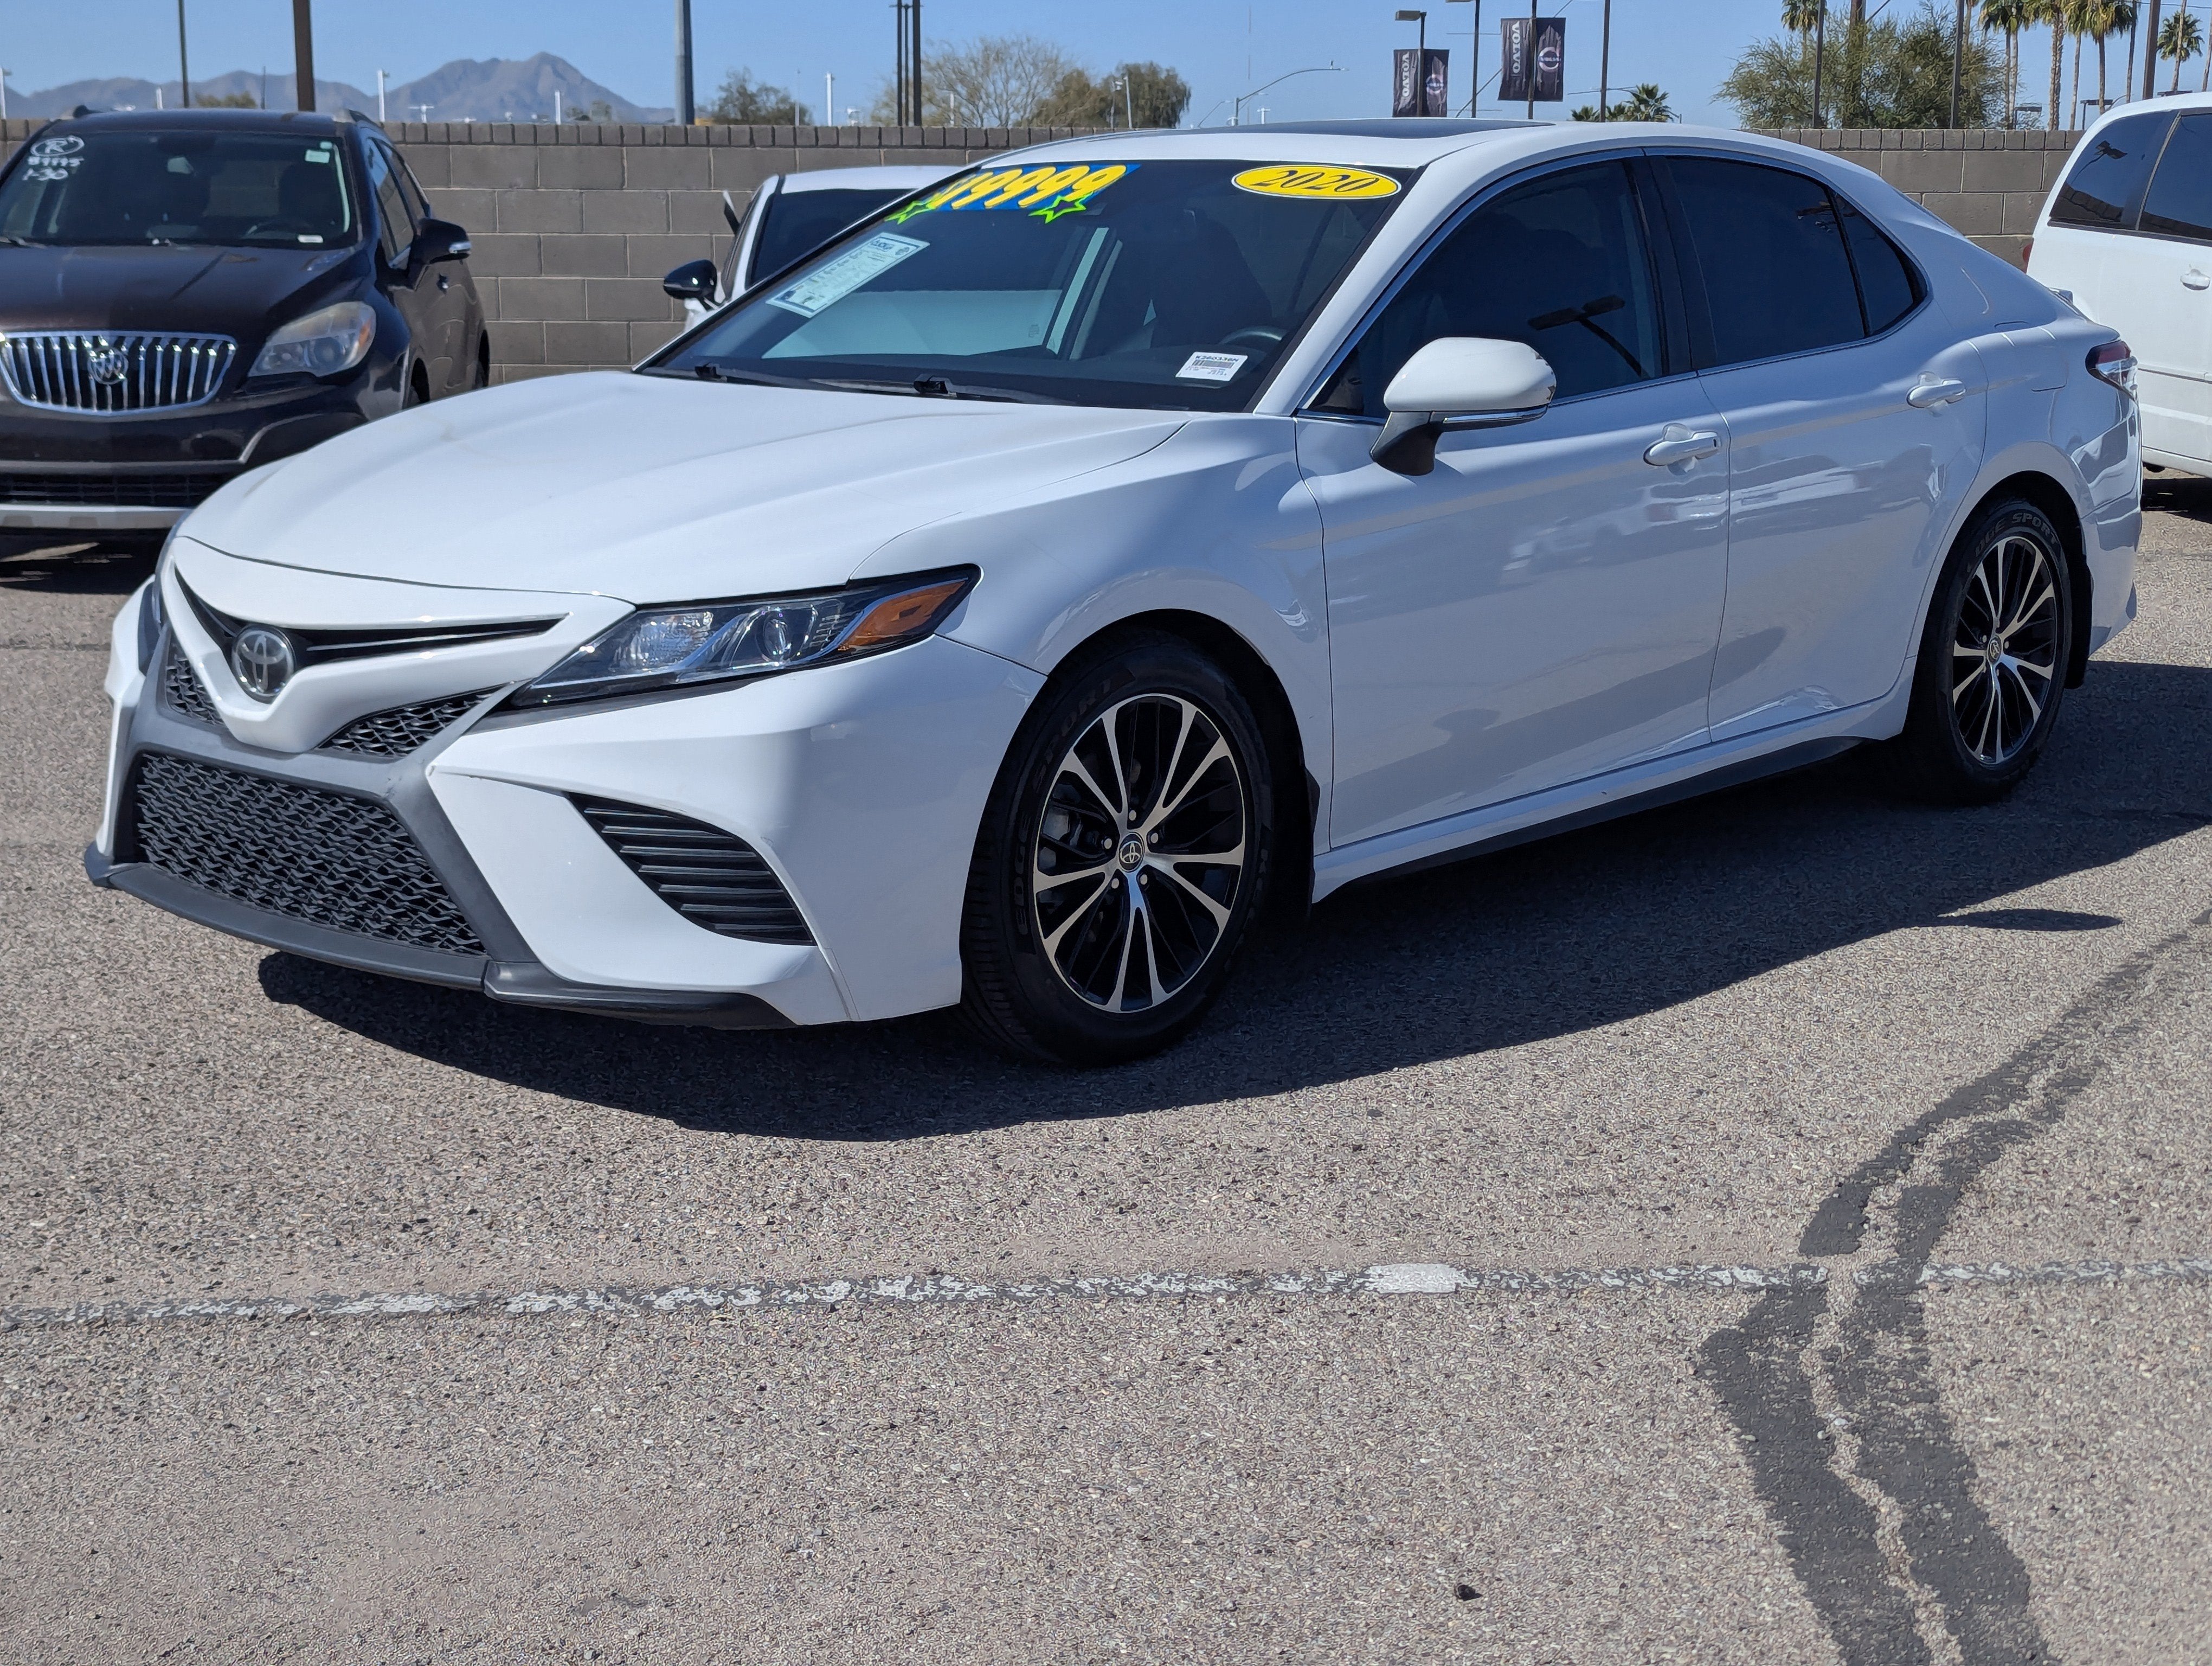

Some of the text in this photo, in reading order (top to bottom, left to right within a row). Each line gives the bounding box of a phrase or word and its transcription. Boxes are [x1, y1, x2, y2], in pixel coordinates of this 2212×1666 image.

[1512, 21, 1520, 74] VOLVO
[1249, 170, 1380, 193] 2020
[2011, 512, 2060, 544] SPORT
